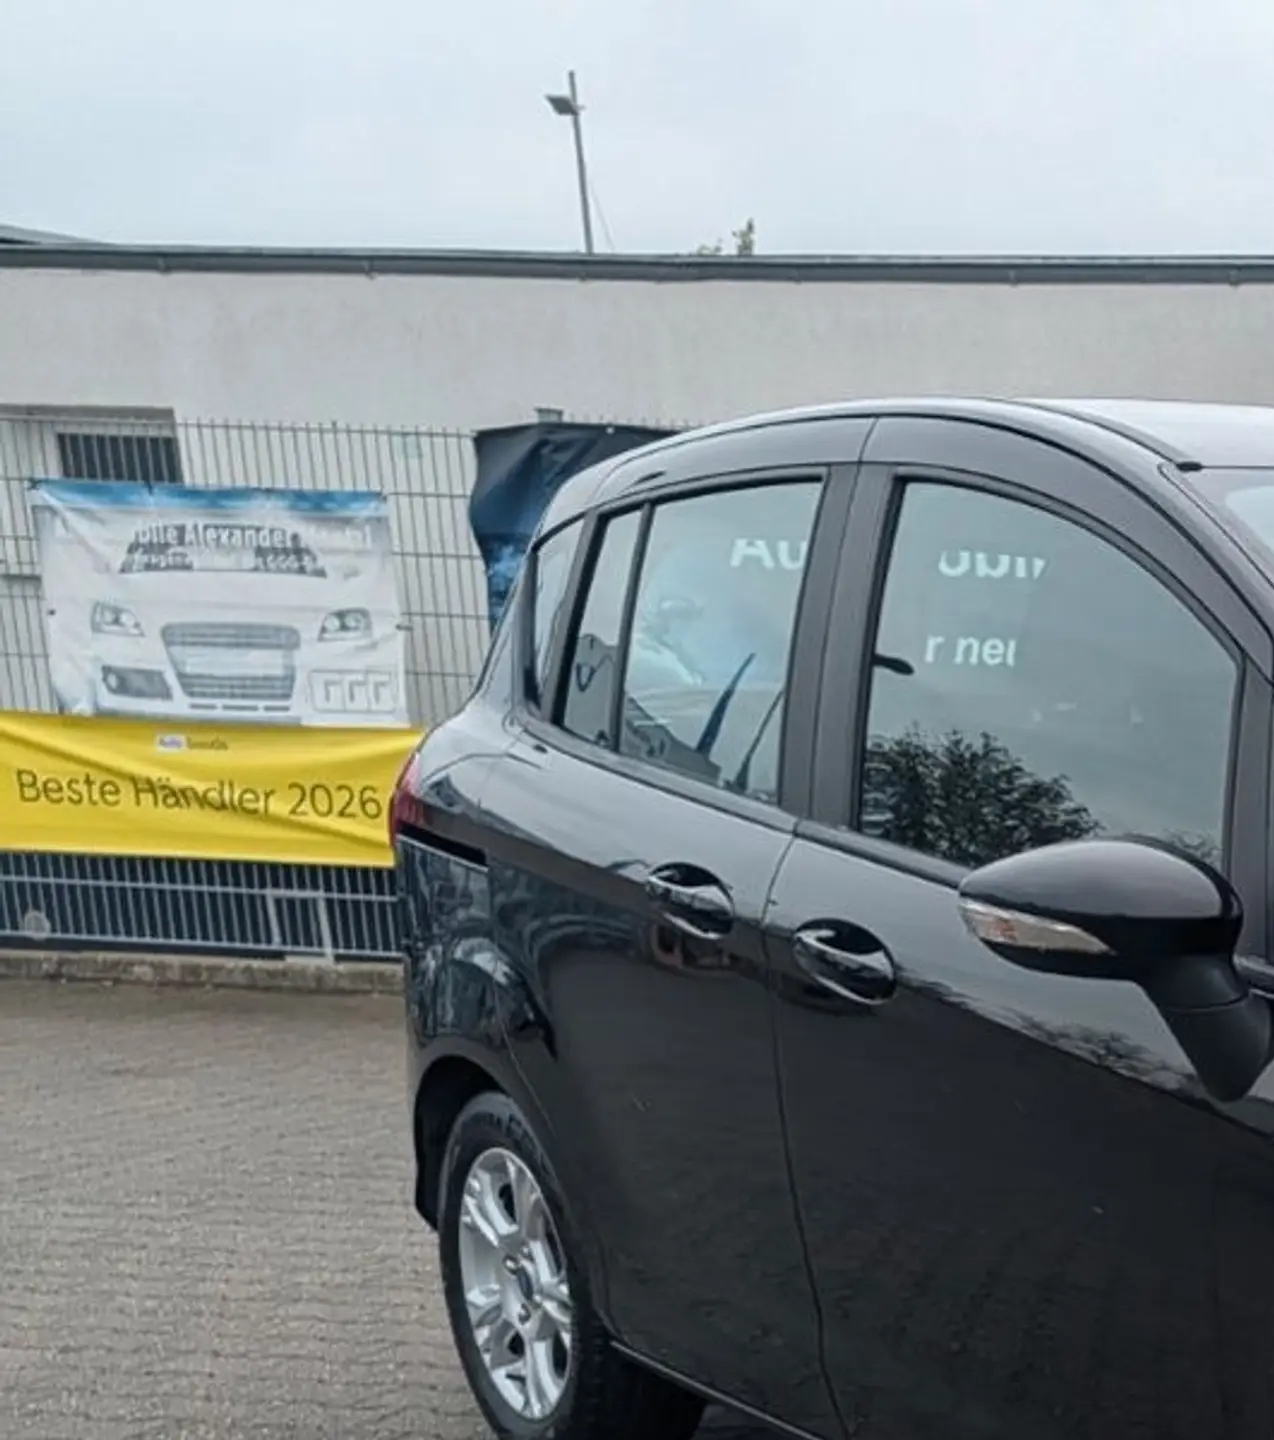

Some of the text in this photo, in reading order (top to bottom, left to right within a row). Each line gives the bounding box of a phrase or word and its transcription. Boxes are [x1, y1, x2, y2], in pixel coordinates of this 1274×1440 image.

[16, 769, 383, 820] Beste Händler 2026
